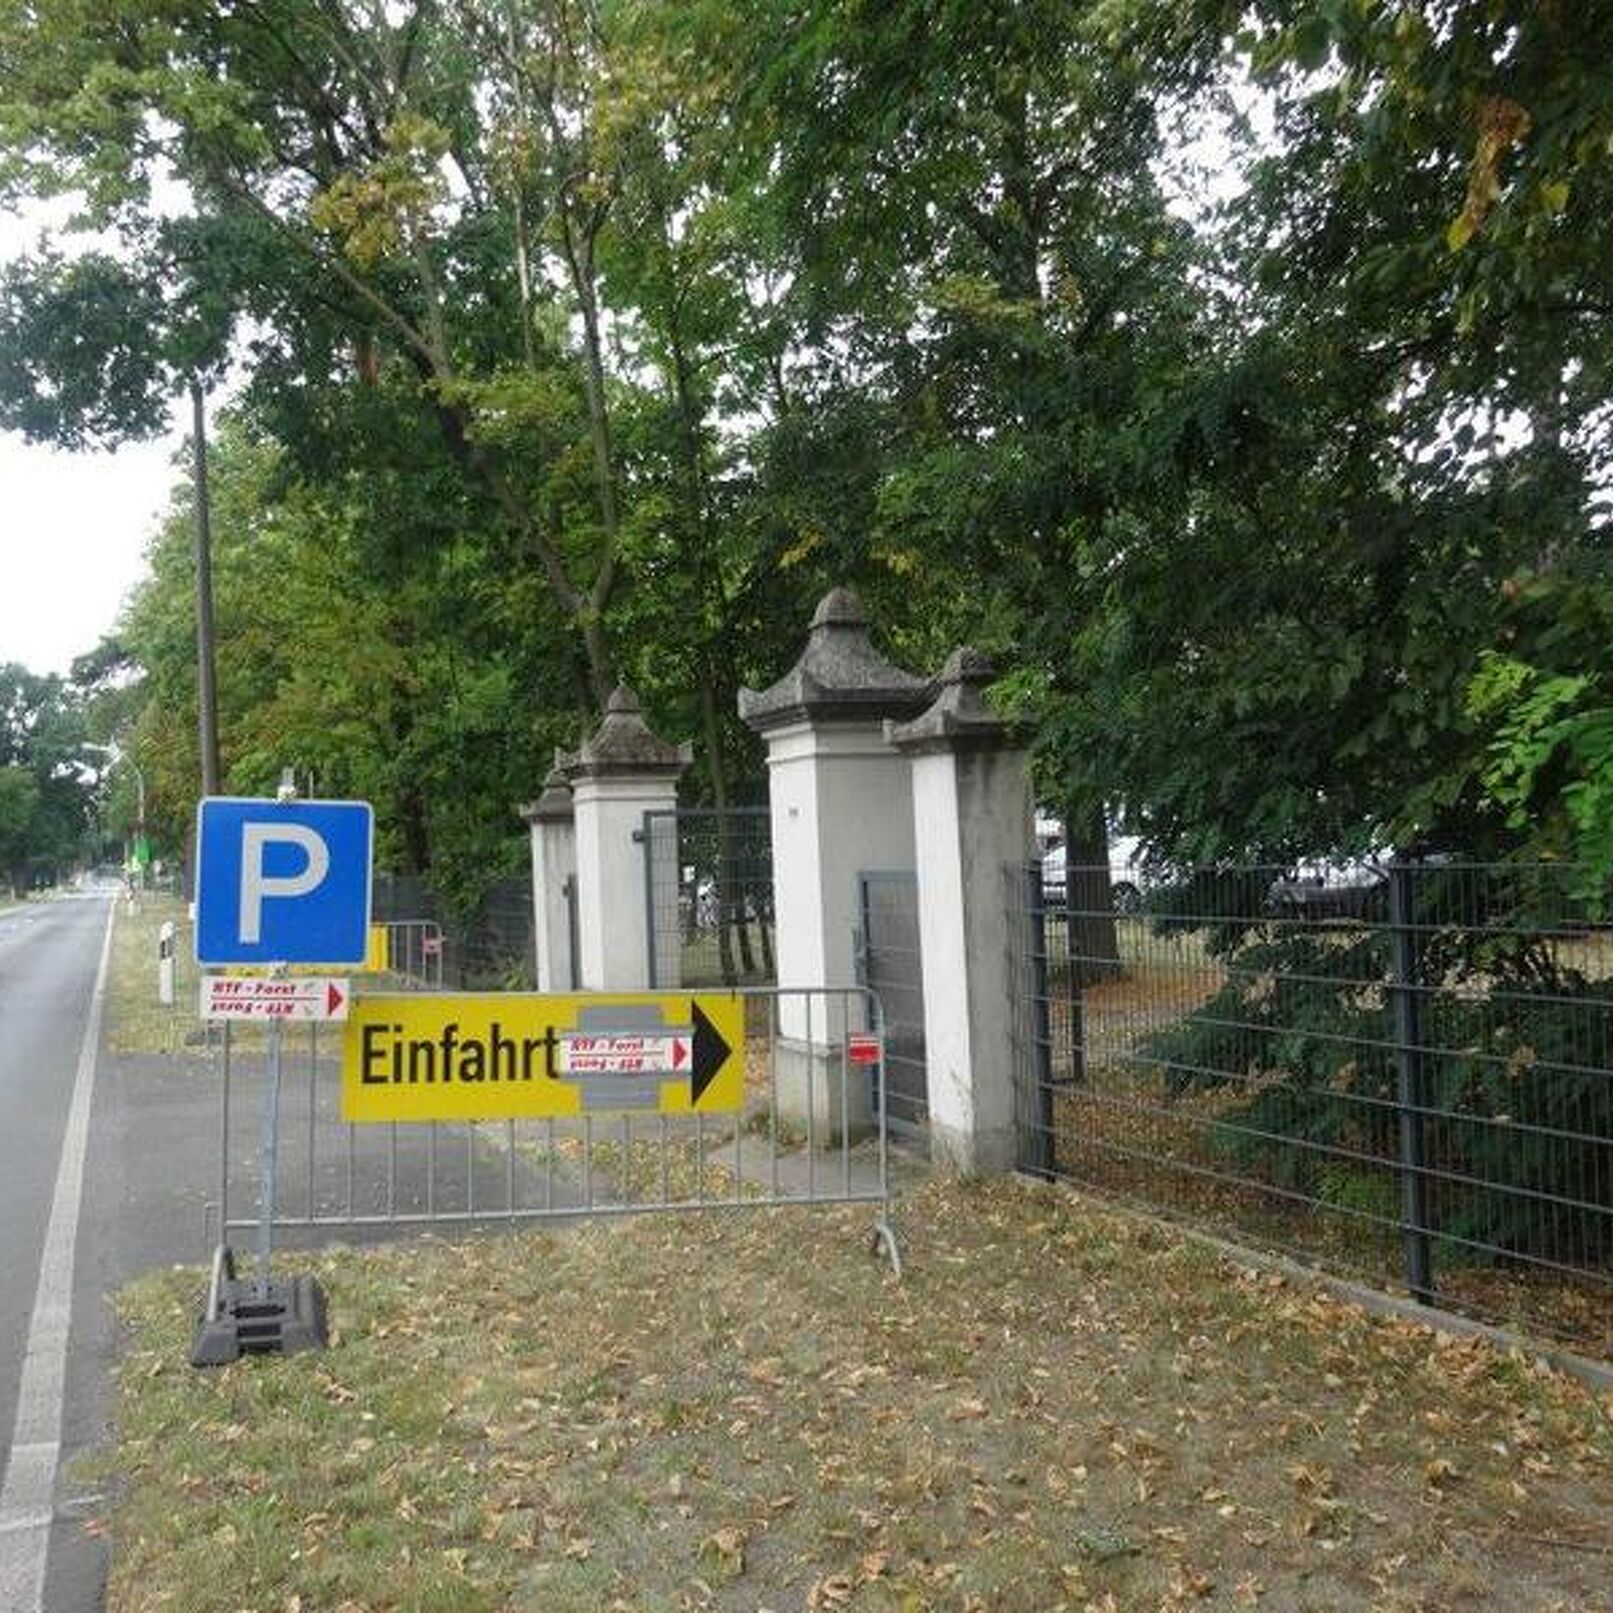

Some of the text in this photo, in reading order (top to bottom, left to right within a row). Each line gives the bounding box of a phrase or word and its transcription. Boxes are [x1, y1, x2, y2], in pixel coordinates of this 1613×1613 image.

[239, 821, 330, 943] P
[212, 982, 241, 994] RTF
[255, 983, 297, 995] Forst
[361, 1022, 561, 1084] Einfahrt
[609, 1039, 644, 1051] Forst
